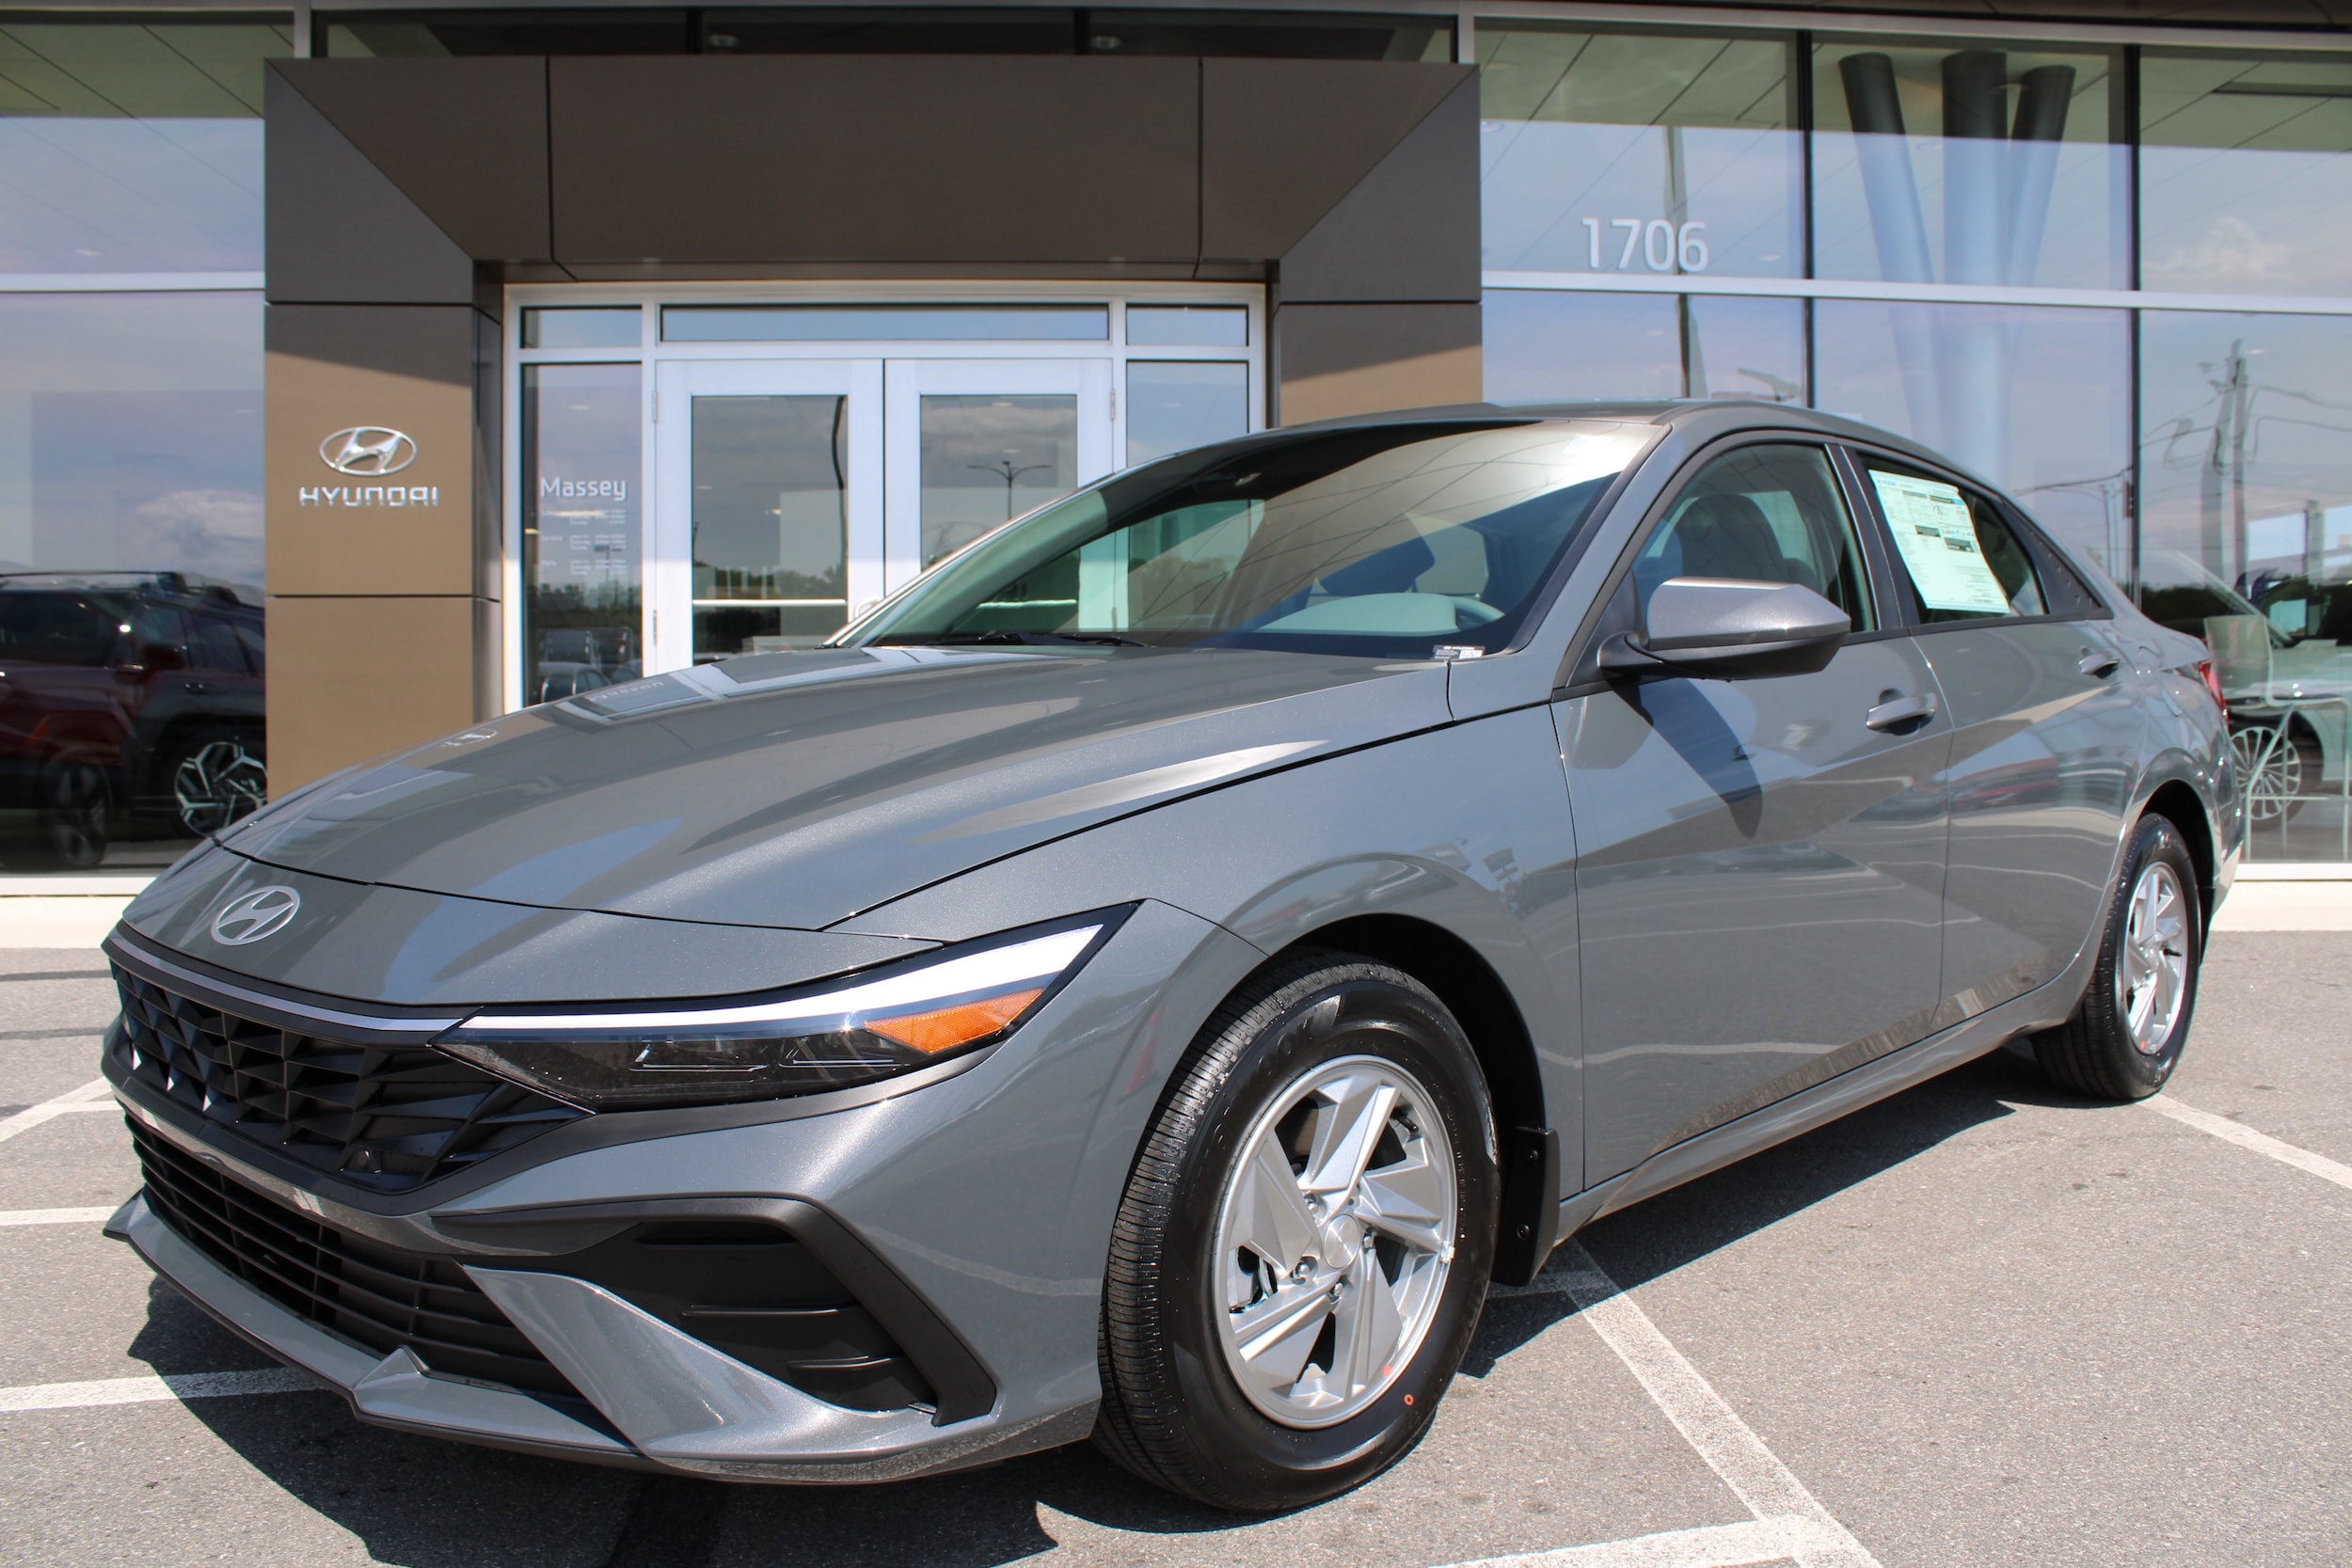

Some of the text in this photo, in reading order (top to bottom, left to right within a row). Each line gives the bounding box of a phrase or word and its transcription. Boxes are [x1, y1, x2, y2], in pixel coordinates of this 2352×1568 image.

[1581, 217, 1708, 273] 1706
[298, 486, 439, 507] HYUNDAI
[541, 477, 627, 501] Massey
